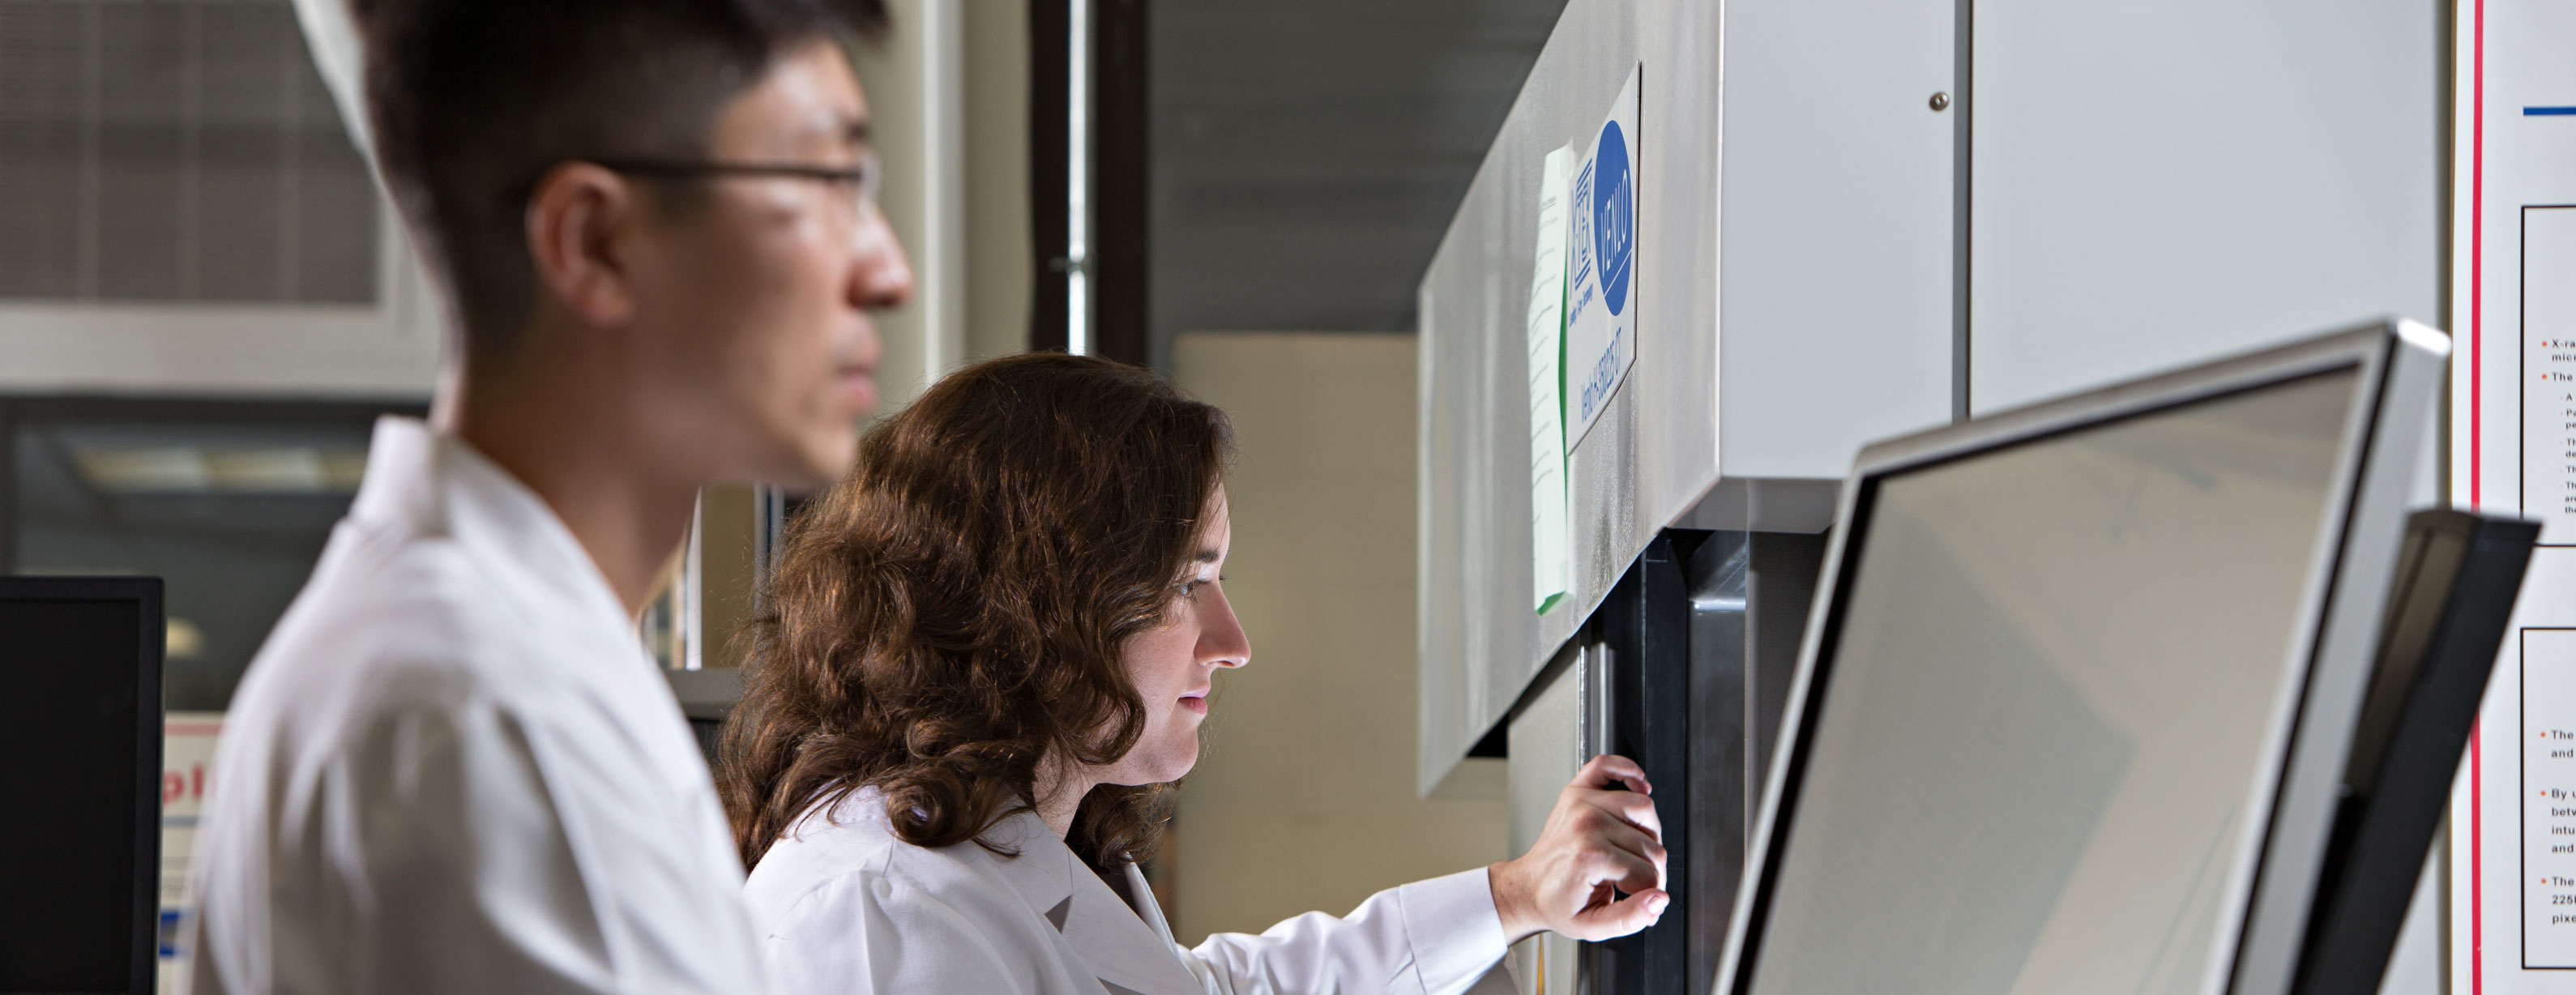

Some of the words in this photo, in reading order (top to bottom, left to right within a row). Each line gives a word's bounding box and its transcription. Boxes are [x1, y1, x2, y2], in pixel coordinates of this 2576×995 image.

[1601, 169, 1628, 279] VENLO
[1616, 326, 1621, 375] CT
[2552, 372, 2573, 381] The
[2551, 730, 2574, 739] The
[2552, 748, 2574, 758] and
[2552, 788, 2567, 801] By
[2552, 843, 2574, 853] and
[2552, 876, 2574, 886] The
